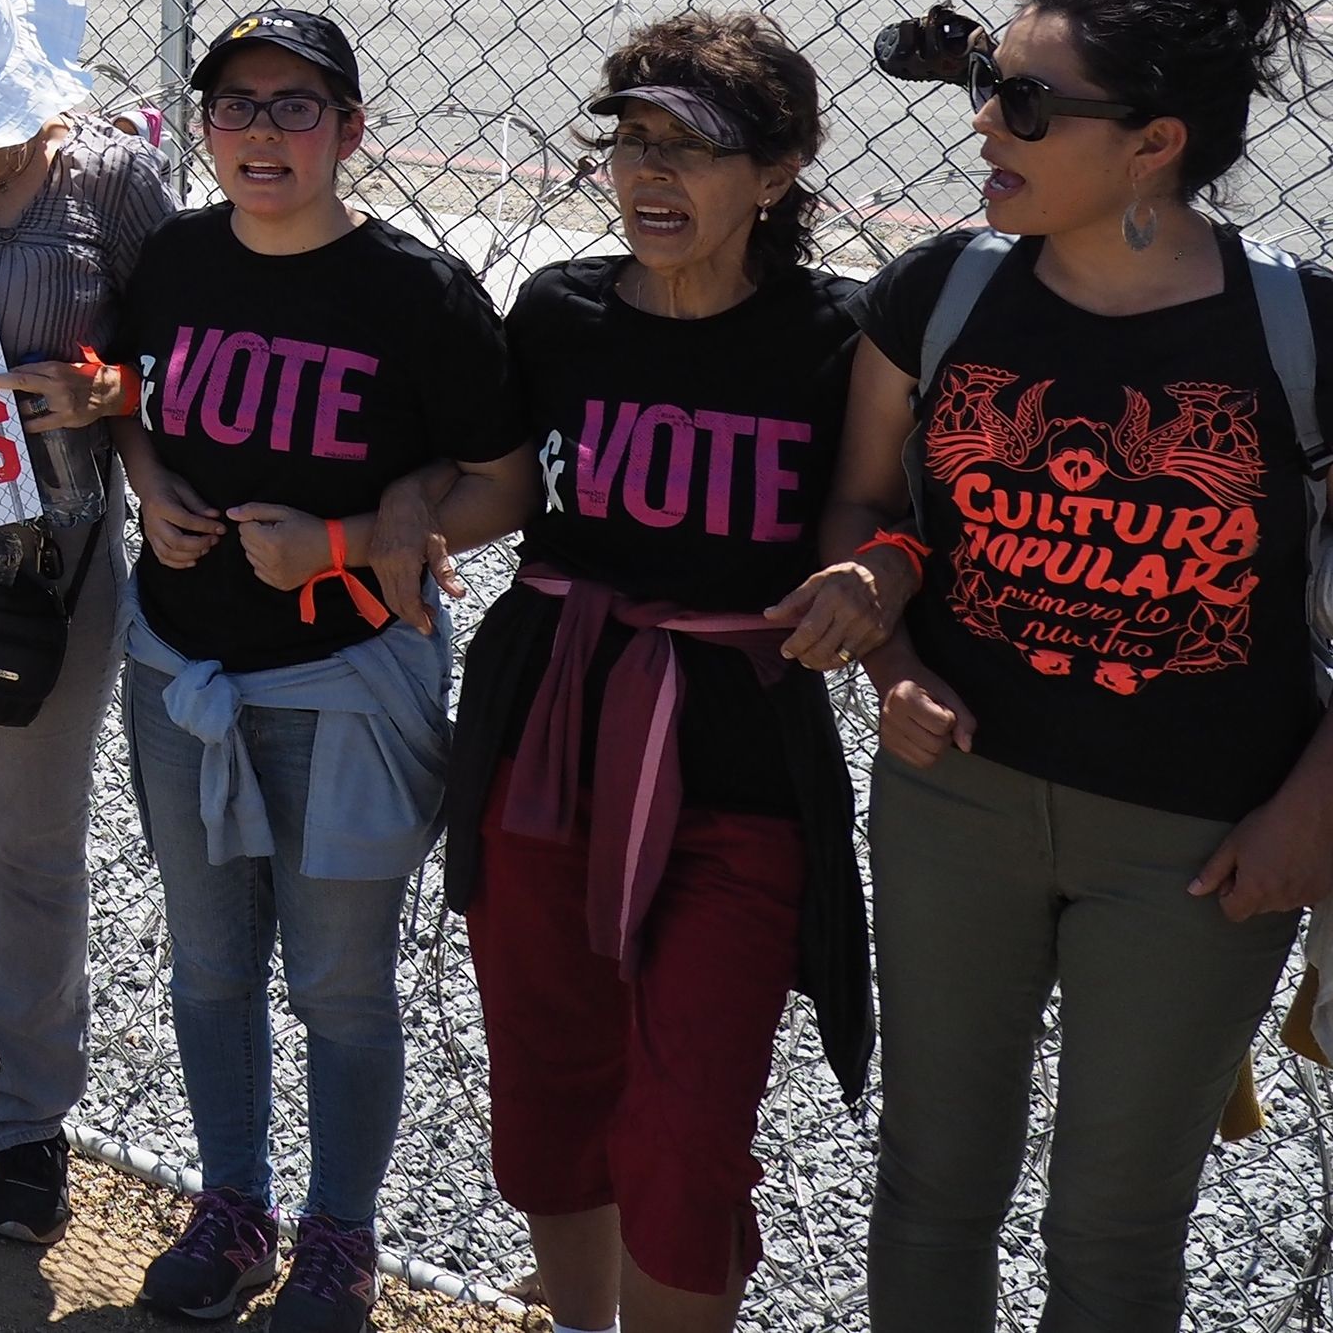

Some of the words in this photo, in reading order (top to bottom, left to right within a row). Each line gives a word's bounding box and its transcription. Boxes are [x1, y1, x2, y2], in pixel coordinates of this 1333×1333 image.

[162, 326, 380, 461] VOTE
[576, 399, 812, 543] VOTE
[951, 472, 1261, 564] CULTURA
[1136, 600, 1171, 625] lo
